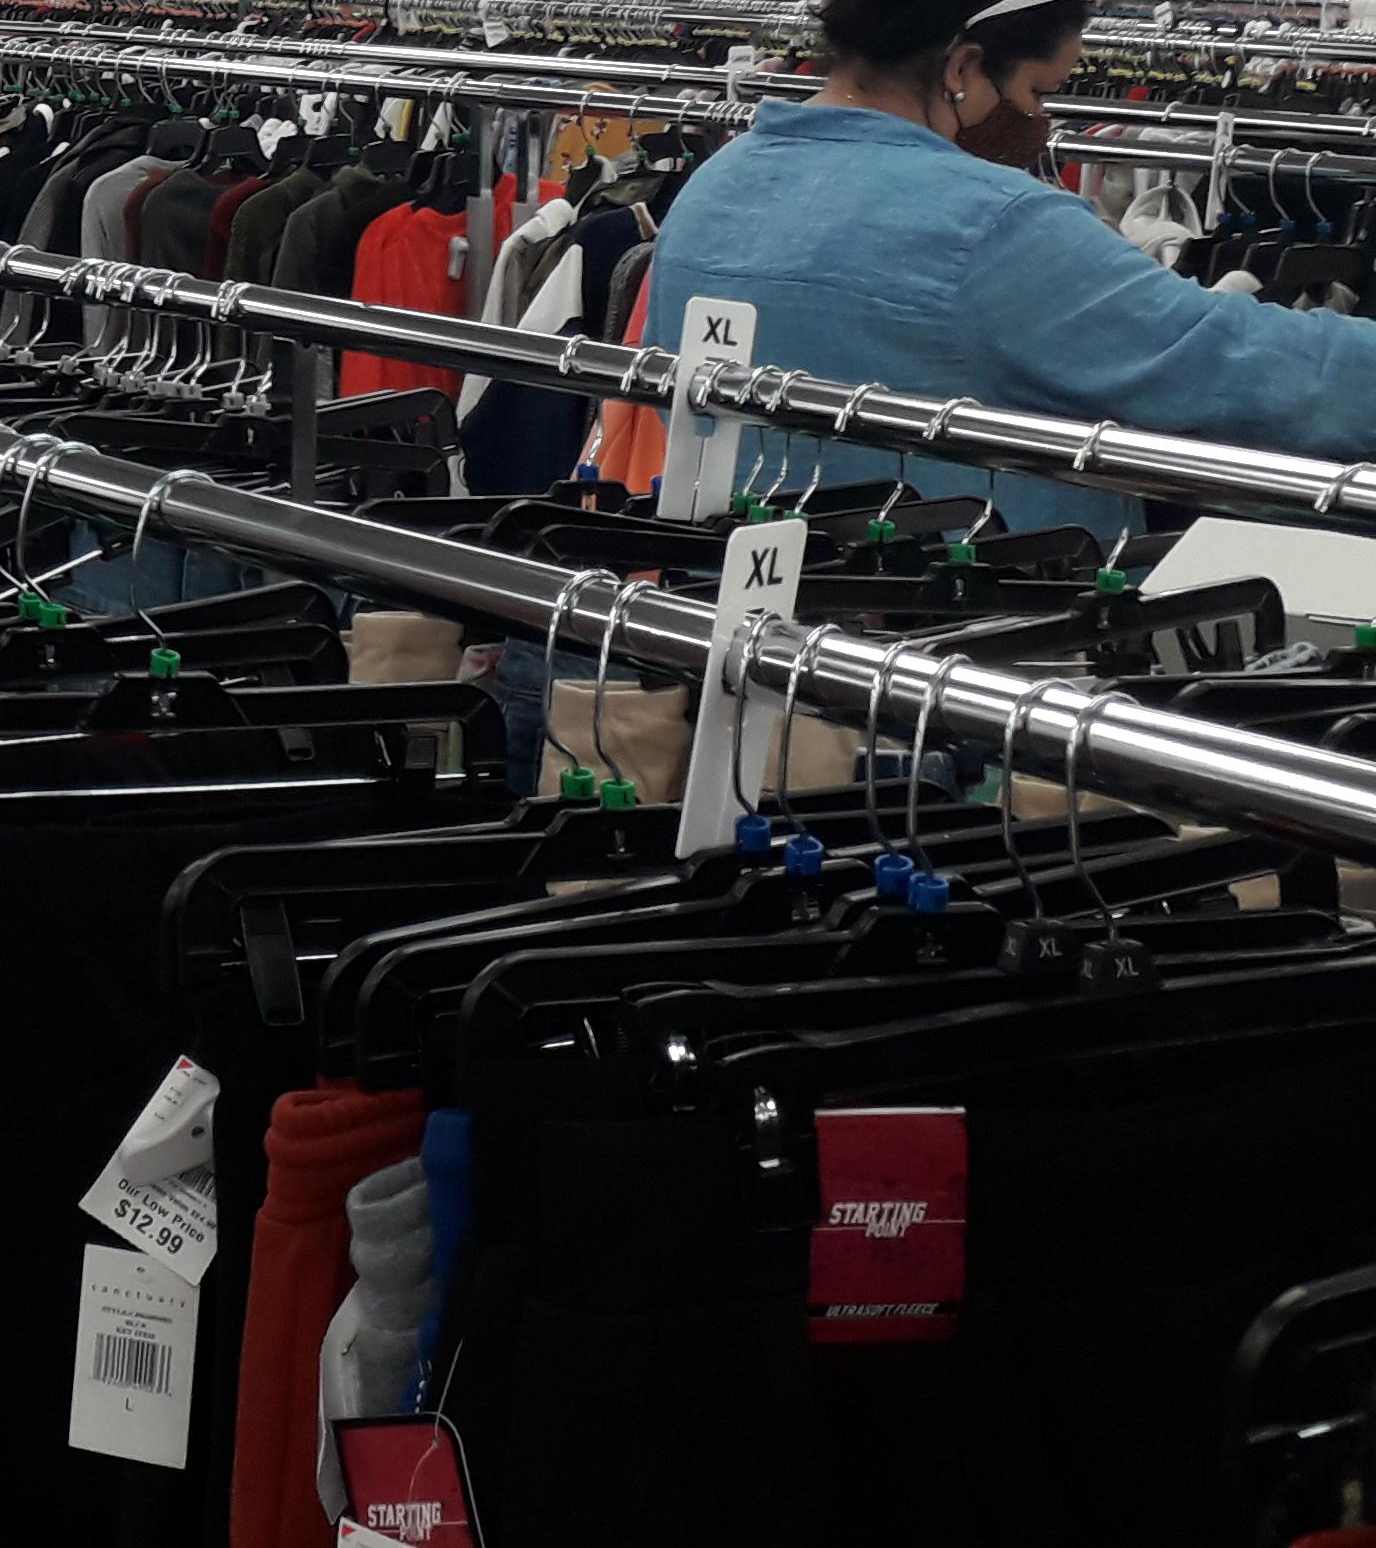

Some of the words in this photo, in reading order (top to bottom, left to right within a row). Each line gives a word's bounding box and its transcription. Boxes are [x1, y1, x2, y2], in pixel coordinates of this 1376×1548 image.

[701, 315, 739, 347] XL
[745, 546, 784, 590] XL
[1038, 937, 1064, 958] XL
[1113, 955, 1140, 980] XL
[118, 1178, 141, 1197] Our
[142, 1193, 170, 1218] Low
[171, 1213, 205, 1244] Price
[828, 1200, 930, 1226] STARTING
[114, 1198, 184, 1255] $12.99
[91, 1283, 186, 1309] sanctuary
[125, 1396, 134, 1412] L
[367, 1500, 443, 1529] STARTING
